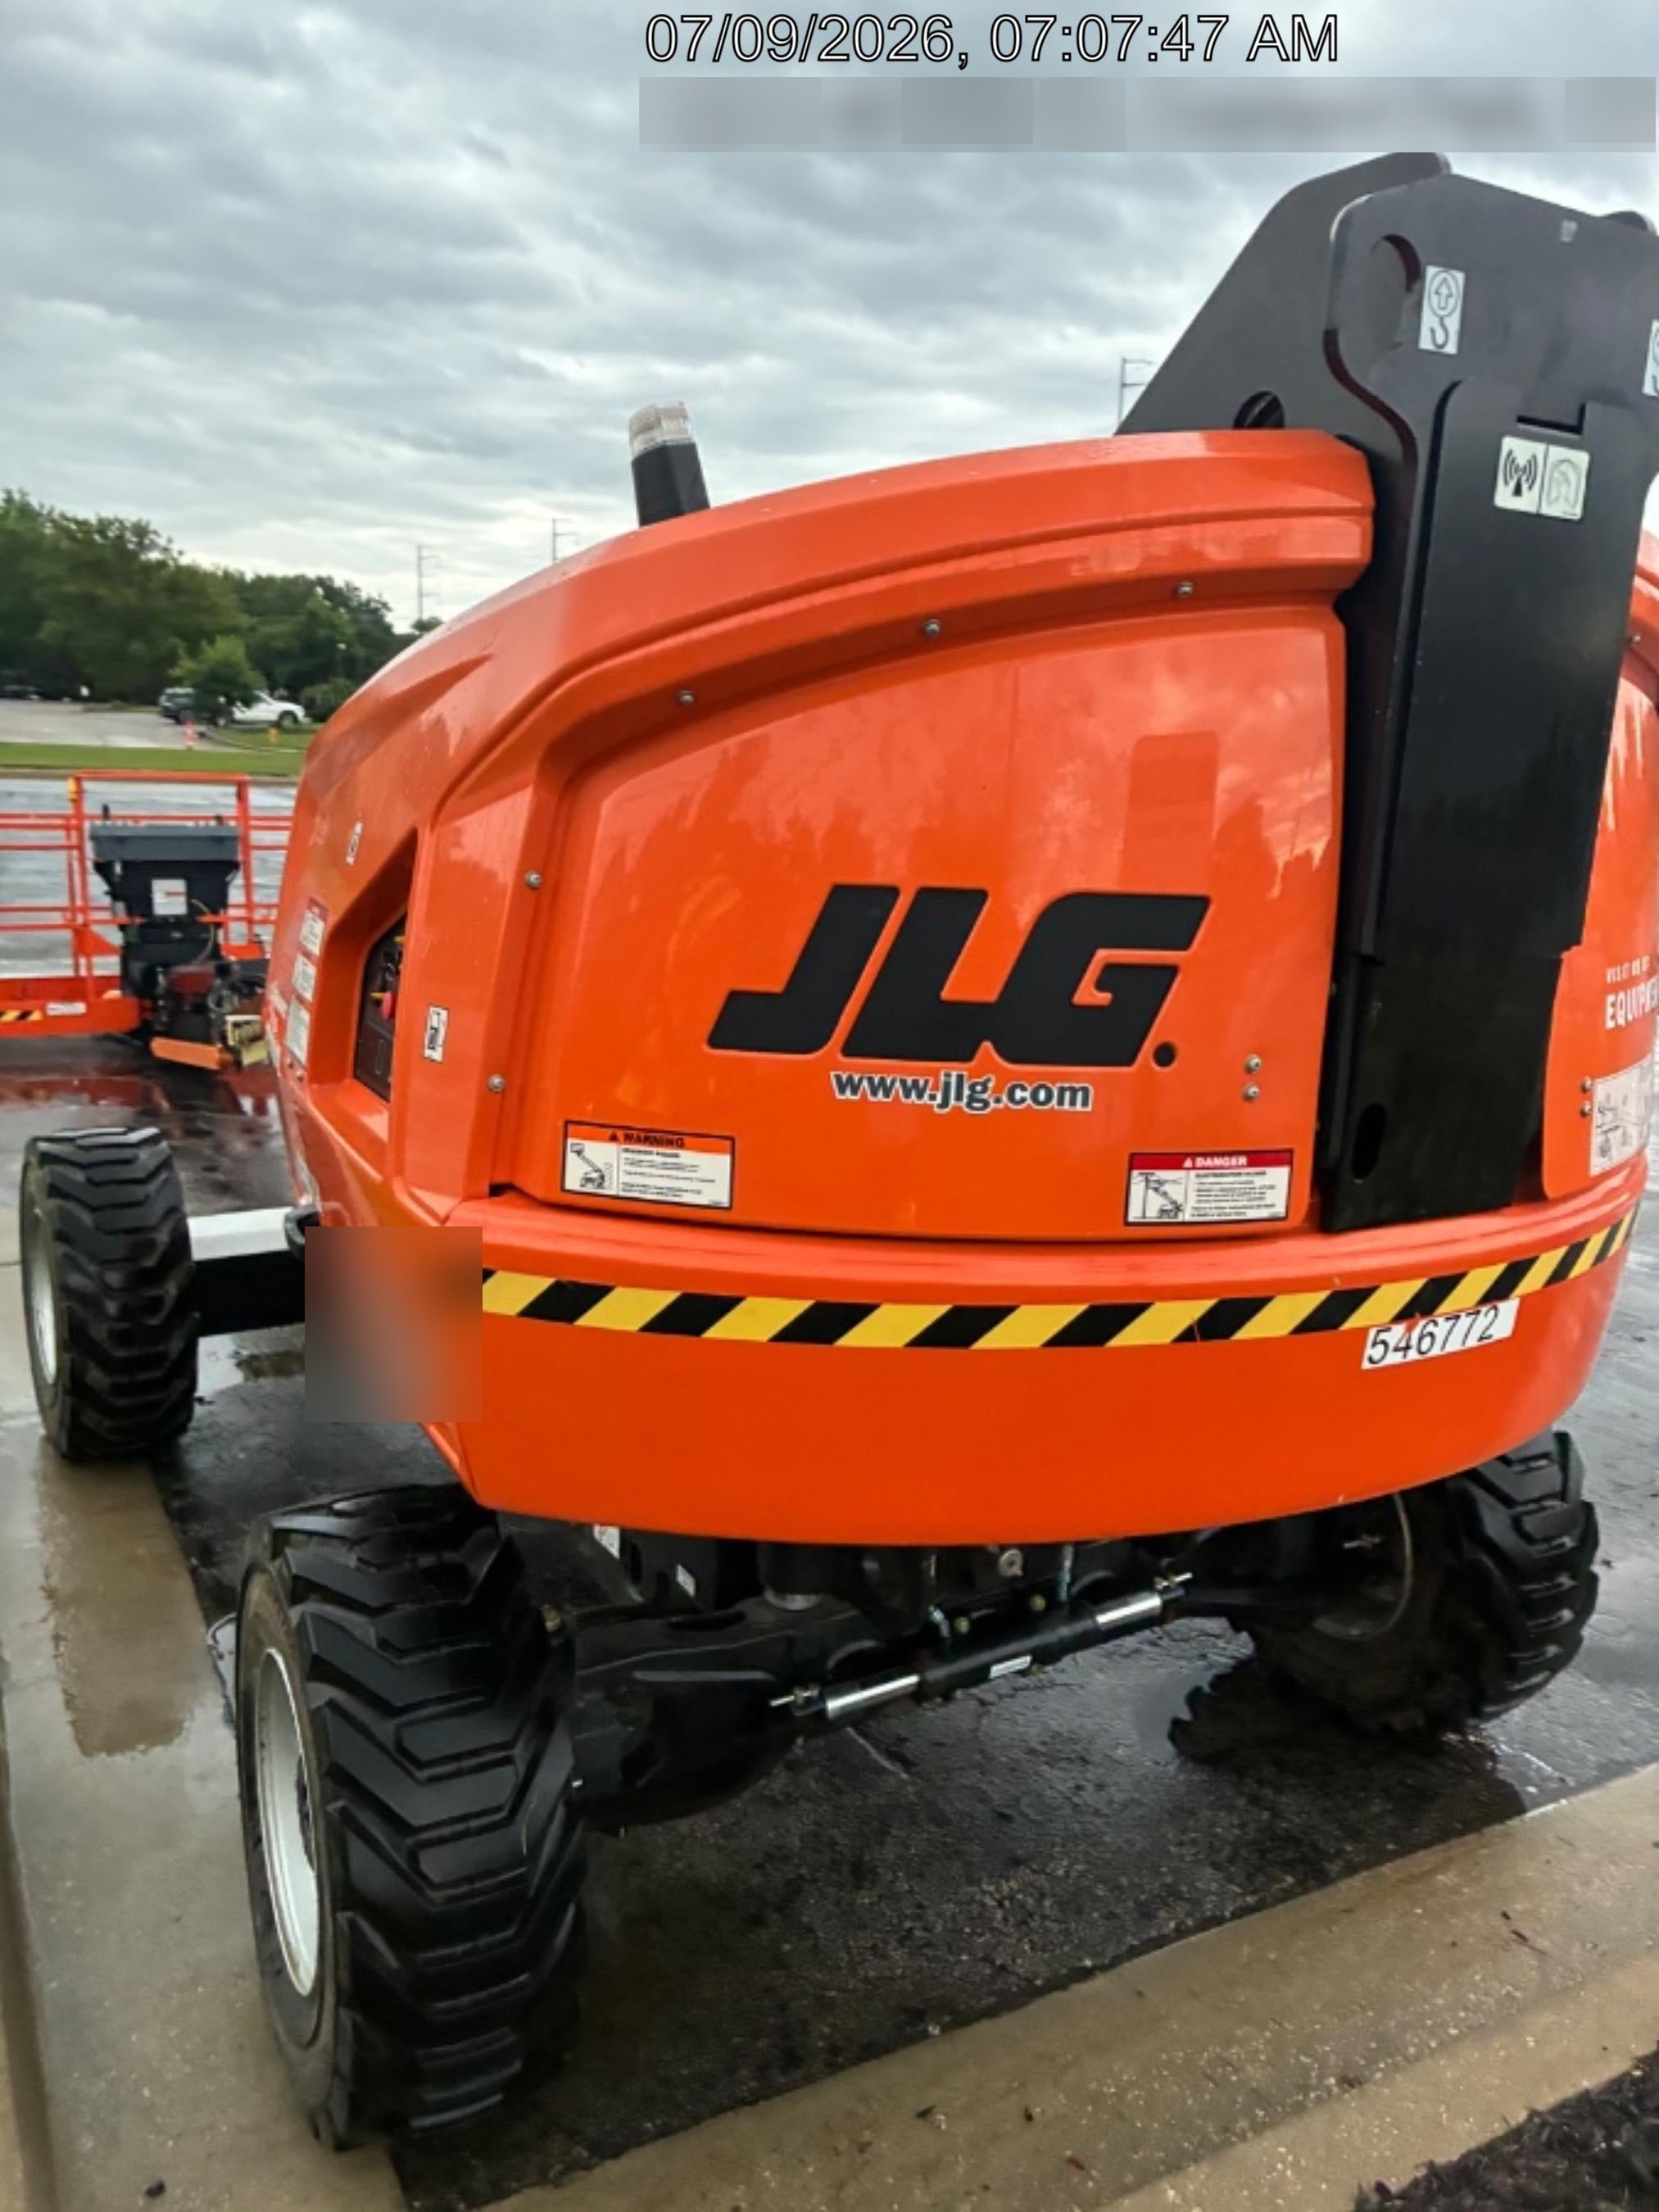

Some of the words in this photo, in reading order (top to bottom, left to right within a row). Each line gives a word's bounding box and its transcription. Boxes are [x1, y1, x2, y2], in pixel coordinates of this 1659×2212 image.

[830, 1070, 1093, 1115] www.jlg.com
[623, 1132, 686, 1149] WARNING
[1194, 1154, 1248, 1168] DANGER
[1367, 1305, 1501, 1365] 546772
